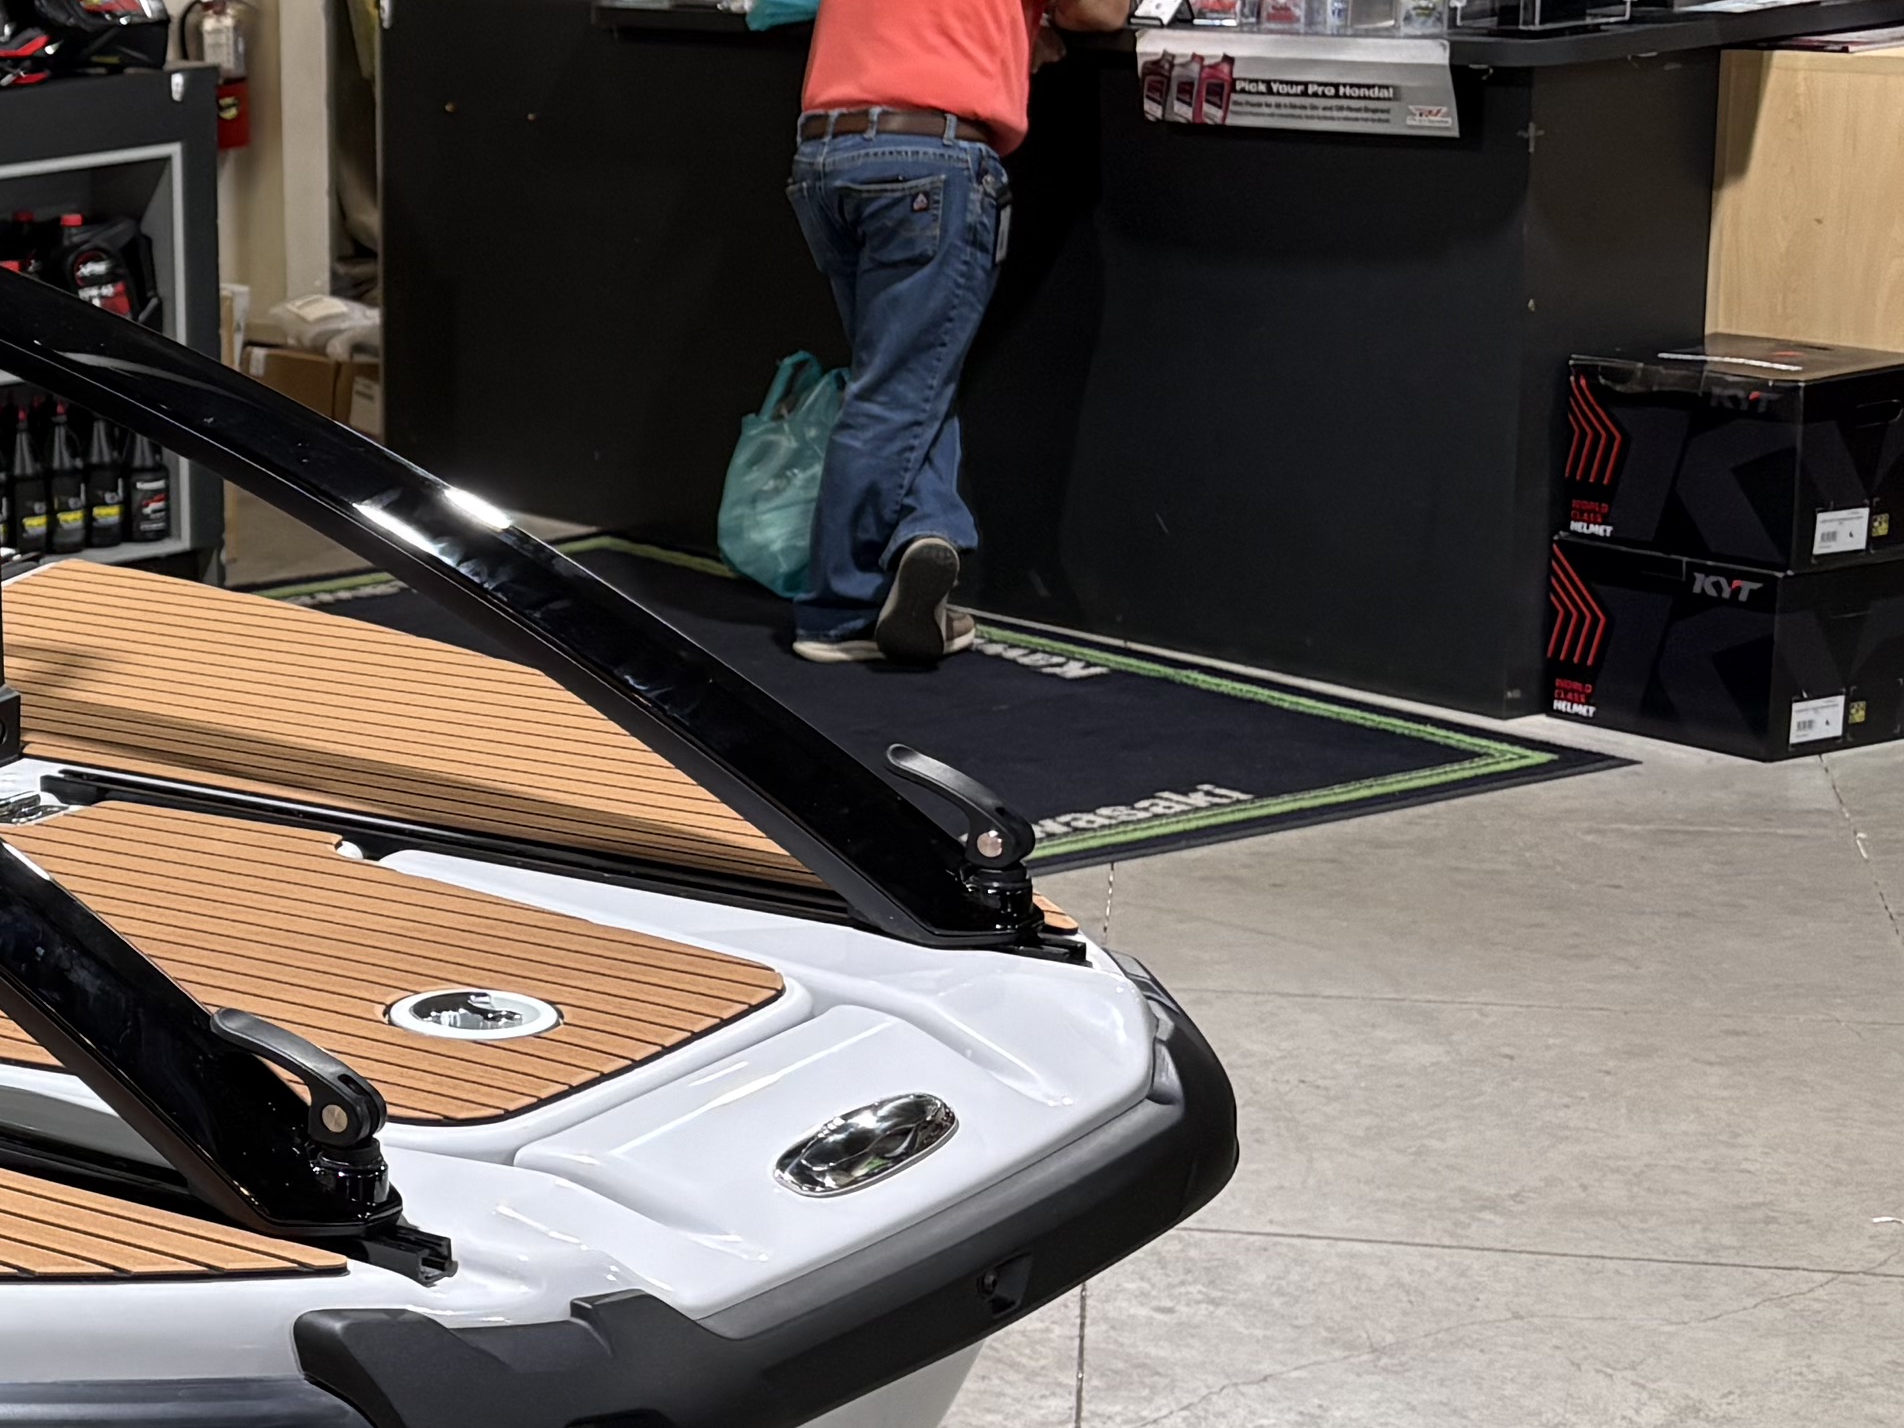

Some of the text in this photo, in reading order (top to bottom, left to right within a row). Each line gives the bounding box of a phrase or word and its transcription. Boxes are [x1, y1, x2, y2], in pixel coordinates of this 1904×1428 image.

[1235, 80, 1268, 93] Pick
[1270, 81, 1305, 95] Your
[1308, 82, 1336, 97] Pro
[1710, 386, 1784, 413] KYT
[1570, 520, 1614, 538] HELMET
[1692, 573, 1765, 603] KYT
[1552, 699, 1597, 718] HELMET
